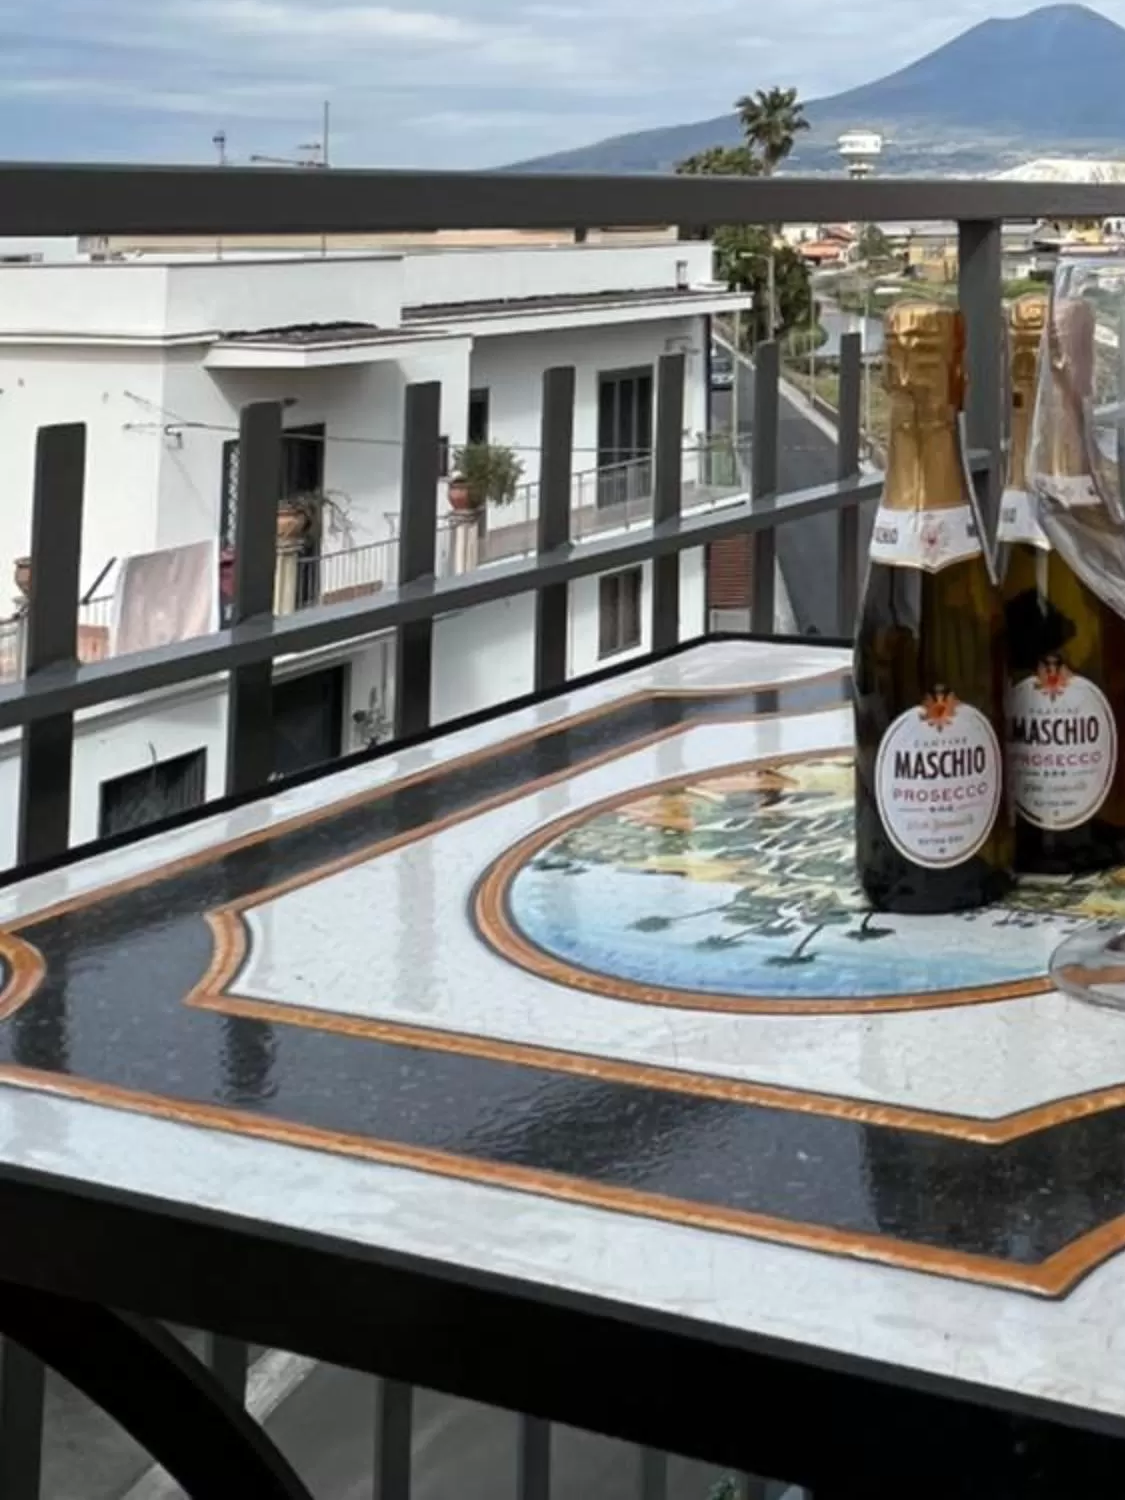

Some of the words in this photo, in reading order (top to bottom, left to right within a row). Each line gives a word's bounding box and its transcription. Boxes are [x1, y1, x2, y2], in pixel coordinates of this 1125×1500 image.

[1012, 715, 1099, 746] MASCHIO
[894, 746, 986, 780] MASCHIO
[892, 782, 988, 803] PROSECCO
